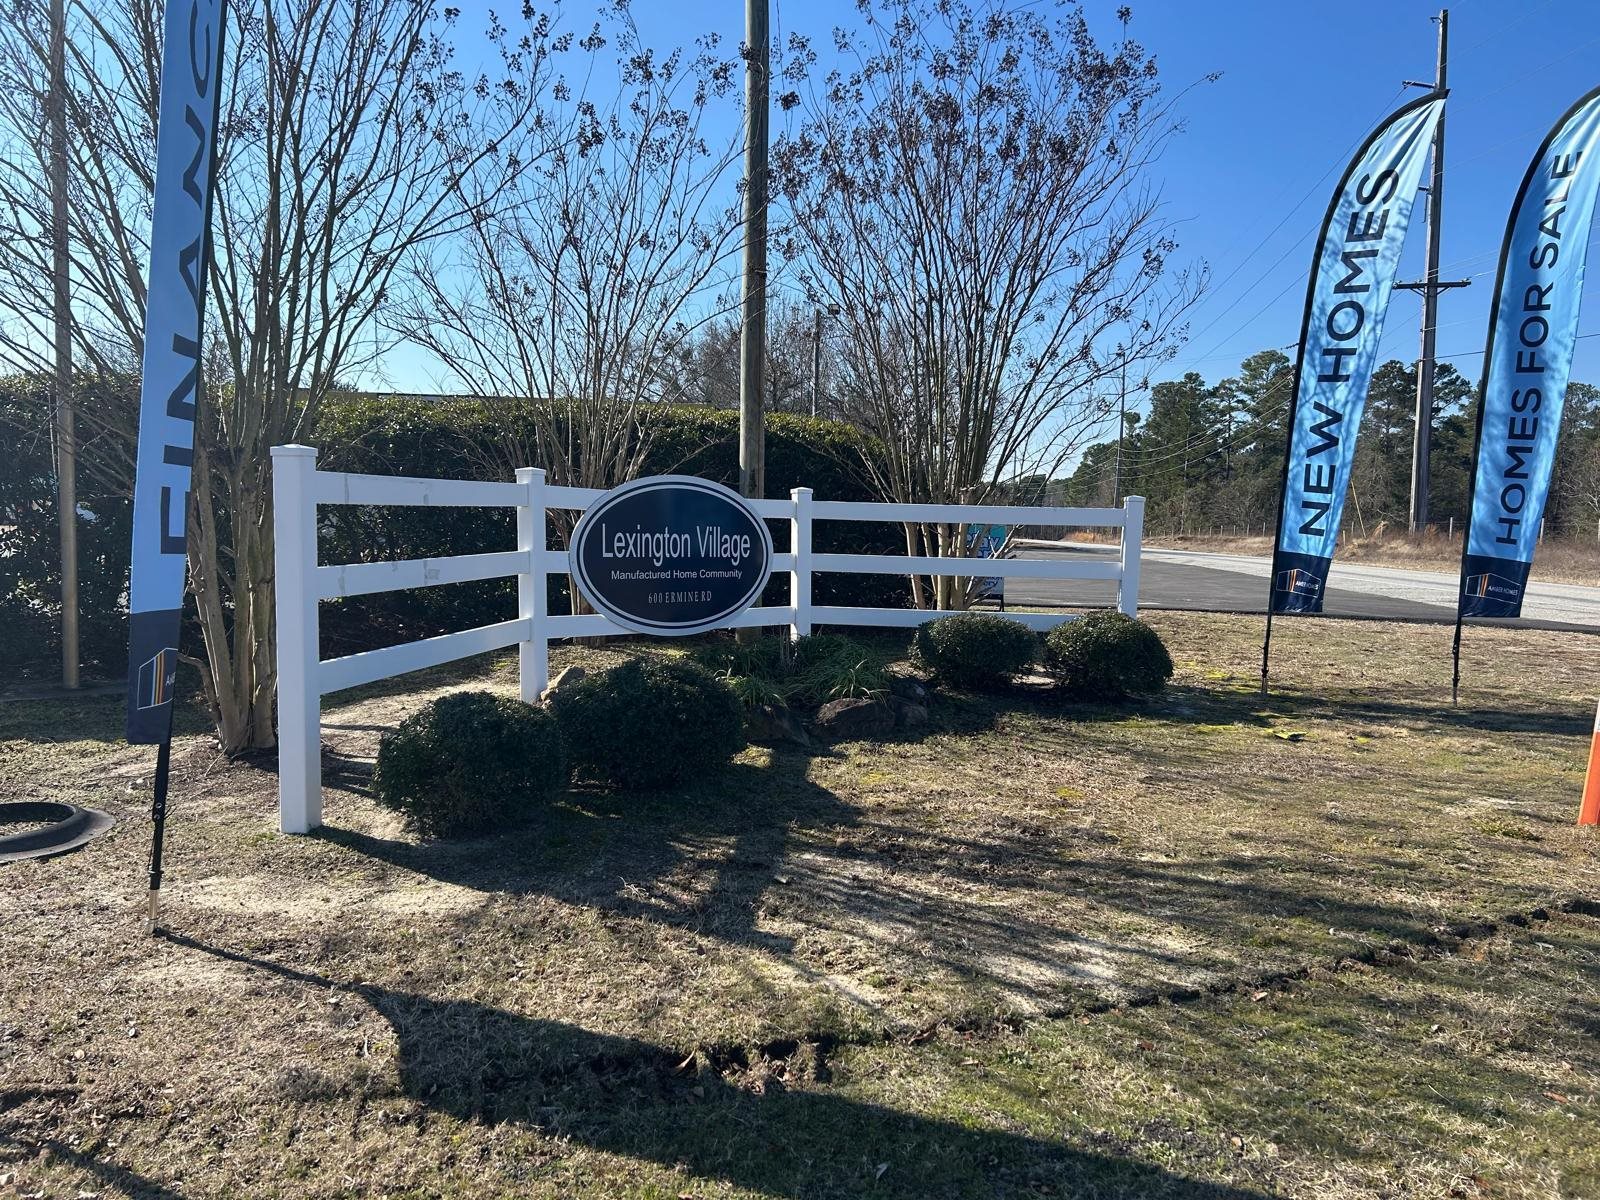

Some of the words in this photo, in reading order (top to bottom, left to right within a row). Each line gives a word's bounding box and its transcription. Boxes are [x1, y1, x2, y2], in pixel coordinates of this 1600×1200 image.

[1528, 149, 1584, 270] SALE
[1317, 168, 1400, 383] HOMES
[1515, 284, 1555, 374] FOR
[1298, 401, 1345, 537] NEW
[1495, 386, 1541, 545] HOMES
[602, 523, 691, 567] Lexington
[696, 525, 751, 566] Village
[611, 570, 671, 580] Manufactured
[673, 569, 698, 579] Home
[699, 569, 743, 579] Community
[648, 592, 663, 603] 600
[665, 591, 699, 603] ERMINE
[701, 590, 712, 601] RD
